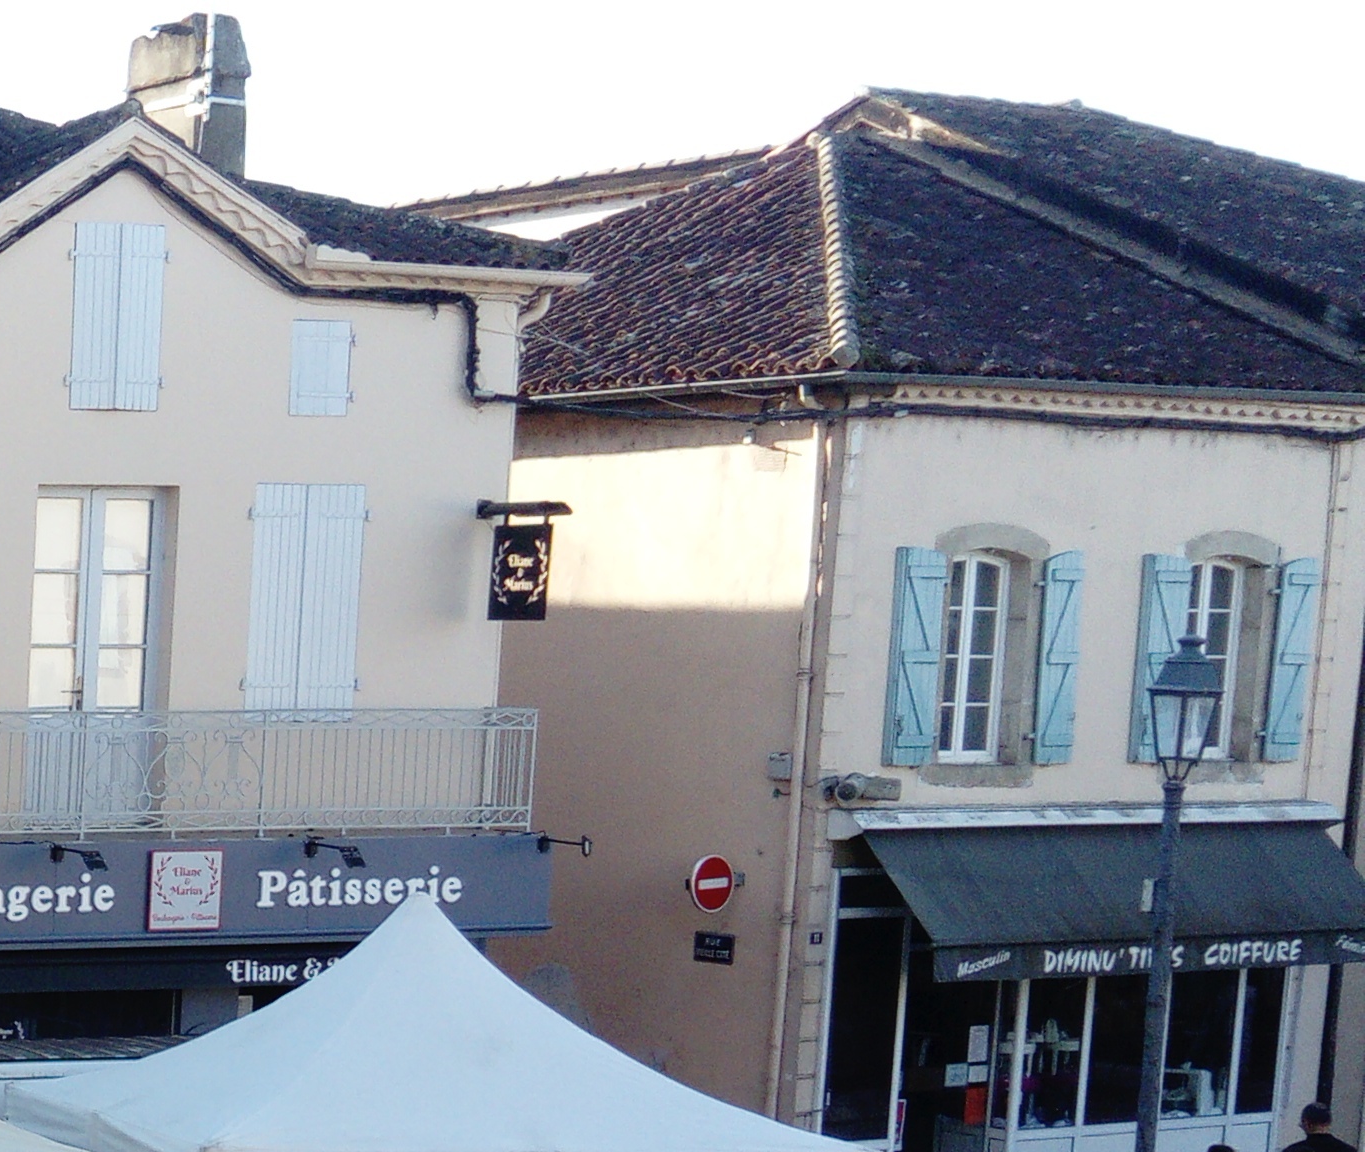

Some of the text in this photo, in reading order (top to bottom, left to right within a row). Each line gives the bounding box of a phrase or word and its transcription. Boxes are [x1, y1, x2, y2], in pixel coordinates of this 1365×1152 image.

[256, 865, 463, 909] Pâtisserie
[957, 950, 1011, 978] Masculin
[1204, 938, 1303, 965] COIFFURE
[226, 958, 298, 983] Eliane
[303, 957, 322, 980] &
